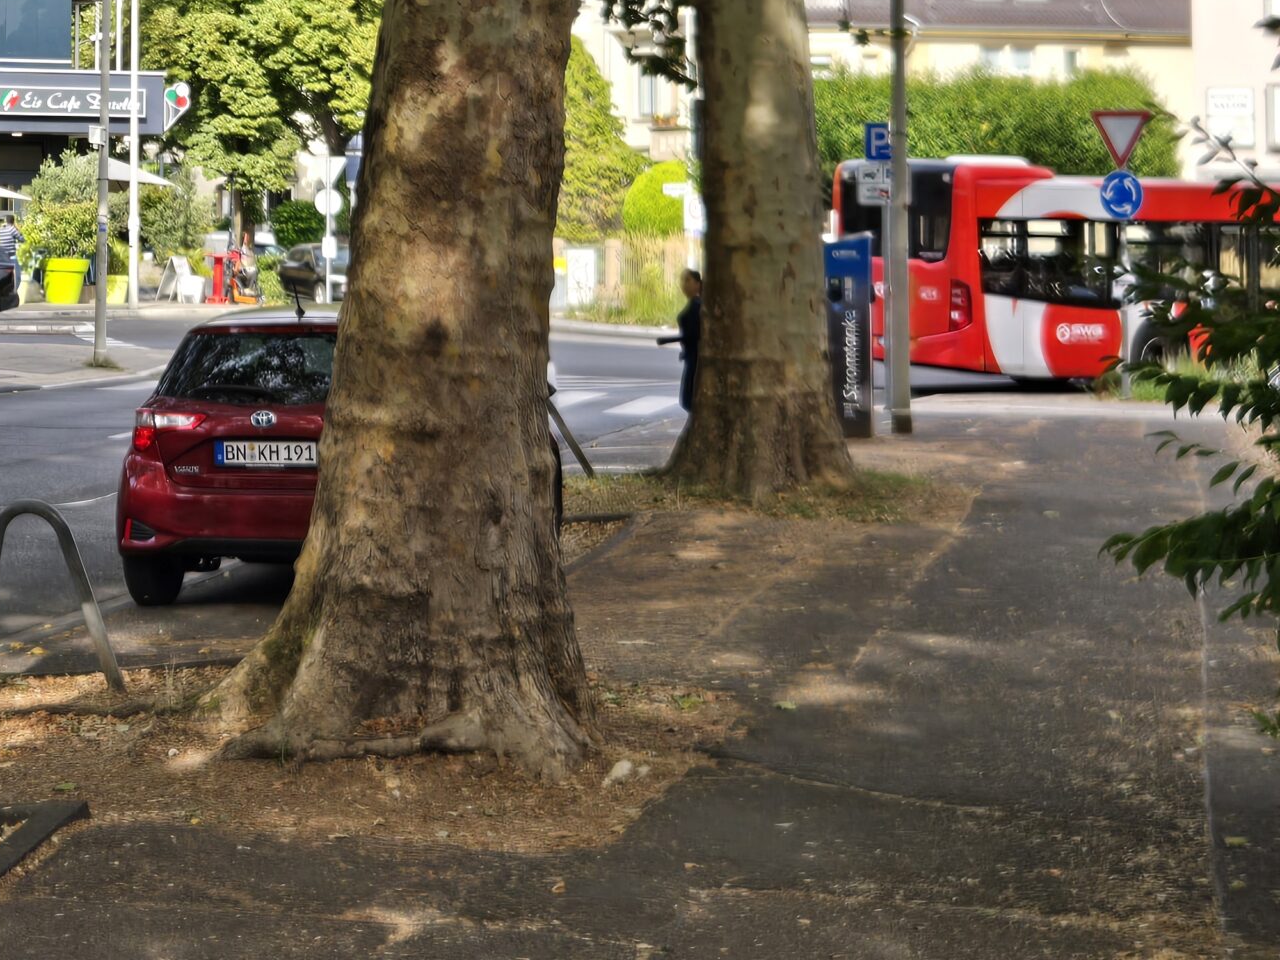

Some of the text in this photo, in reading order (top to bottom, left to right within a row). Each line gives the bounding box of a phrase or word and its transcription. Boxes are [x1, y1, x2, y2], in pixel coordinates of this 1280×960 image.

[20, 91, 43, 109] Eis
[871, 127, 889, 157] P
[842, 309, 858, 400] Stromtanke
[225, 444, 314, 461] BN KH 191
